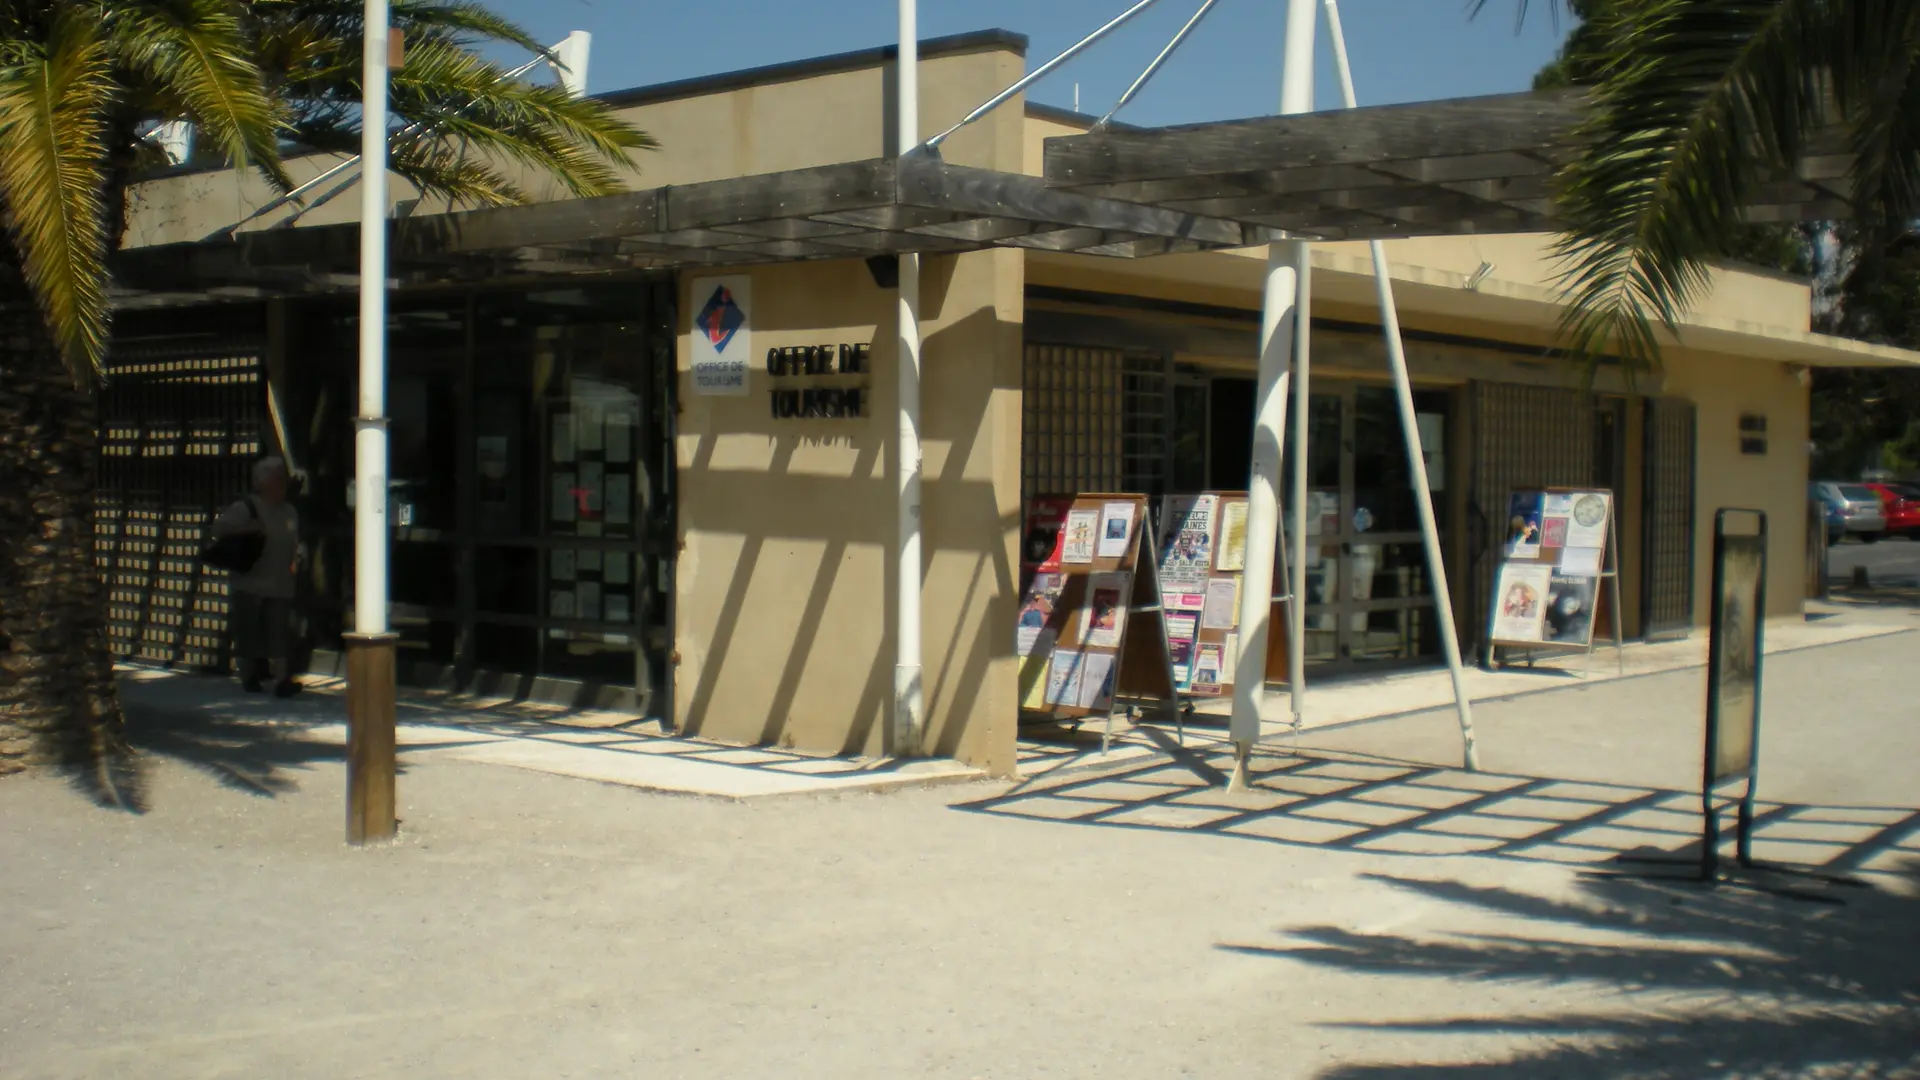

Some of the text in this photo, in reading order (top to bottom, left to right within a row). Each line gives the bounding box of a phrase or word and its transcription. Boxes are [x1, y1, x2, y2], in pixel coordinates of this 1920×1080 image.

[696, 361, 744, 373] OFFICE DE
[767, 343, 871, 375] OFFICE DE
[697, 375, 743, 386] TOURISME
[768, 388, 870, 418] TOURISME
